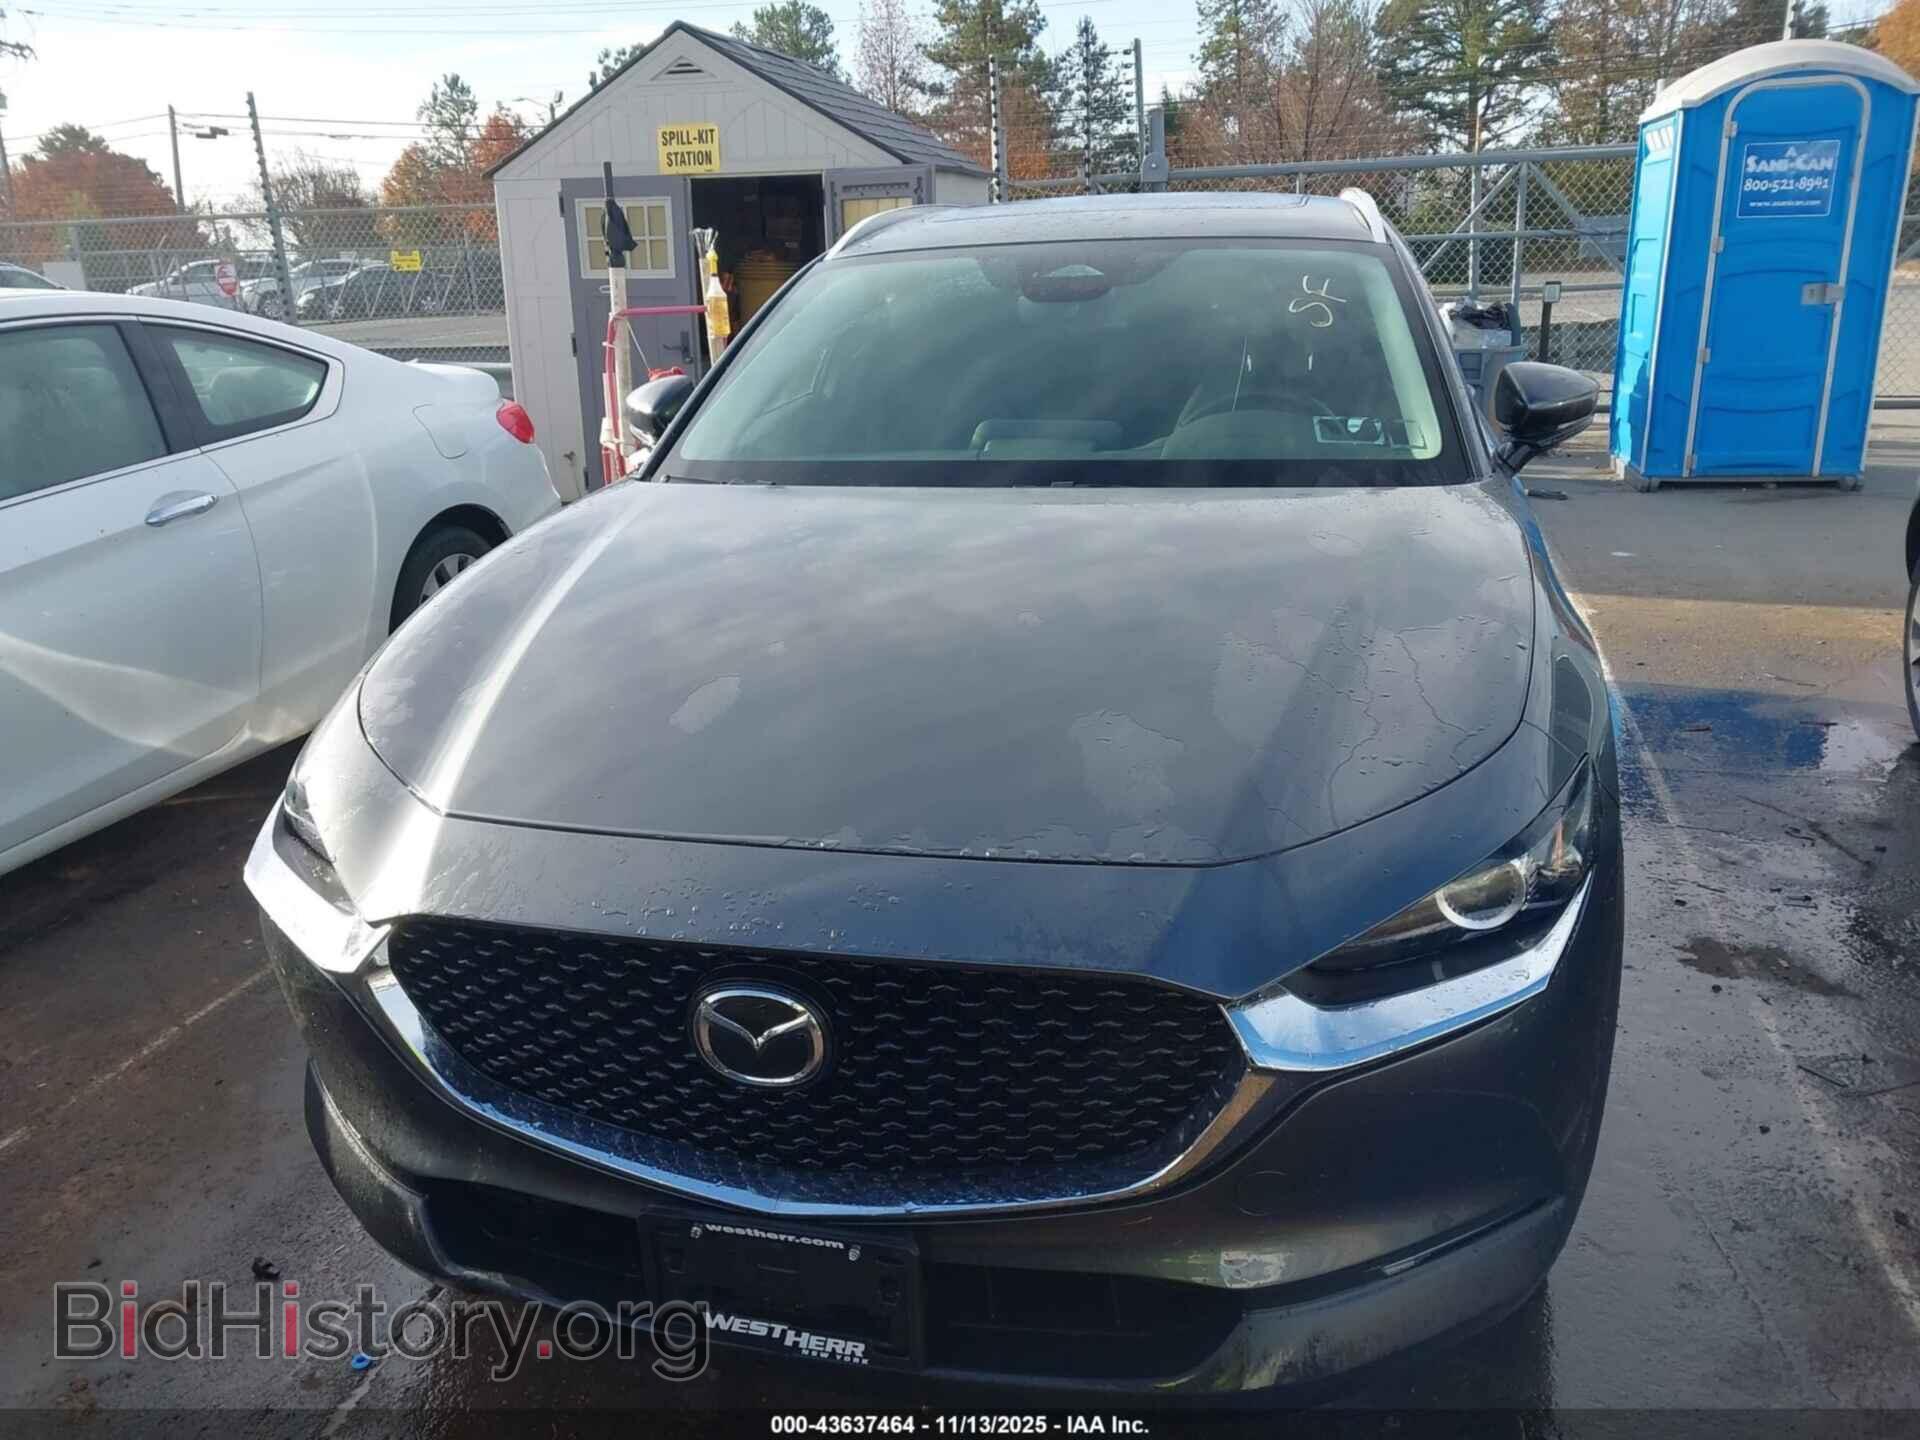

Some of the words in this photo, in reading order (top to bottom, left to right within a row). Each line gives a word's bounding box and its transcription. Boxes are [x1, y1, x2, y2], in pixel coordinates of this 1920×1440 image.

[661, 129, 715, 146] SPILL-KIT
[666, 150, 713, 167] STATION
[705, 1223, 845, 1250] westherr.com
